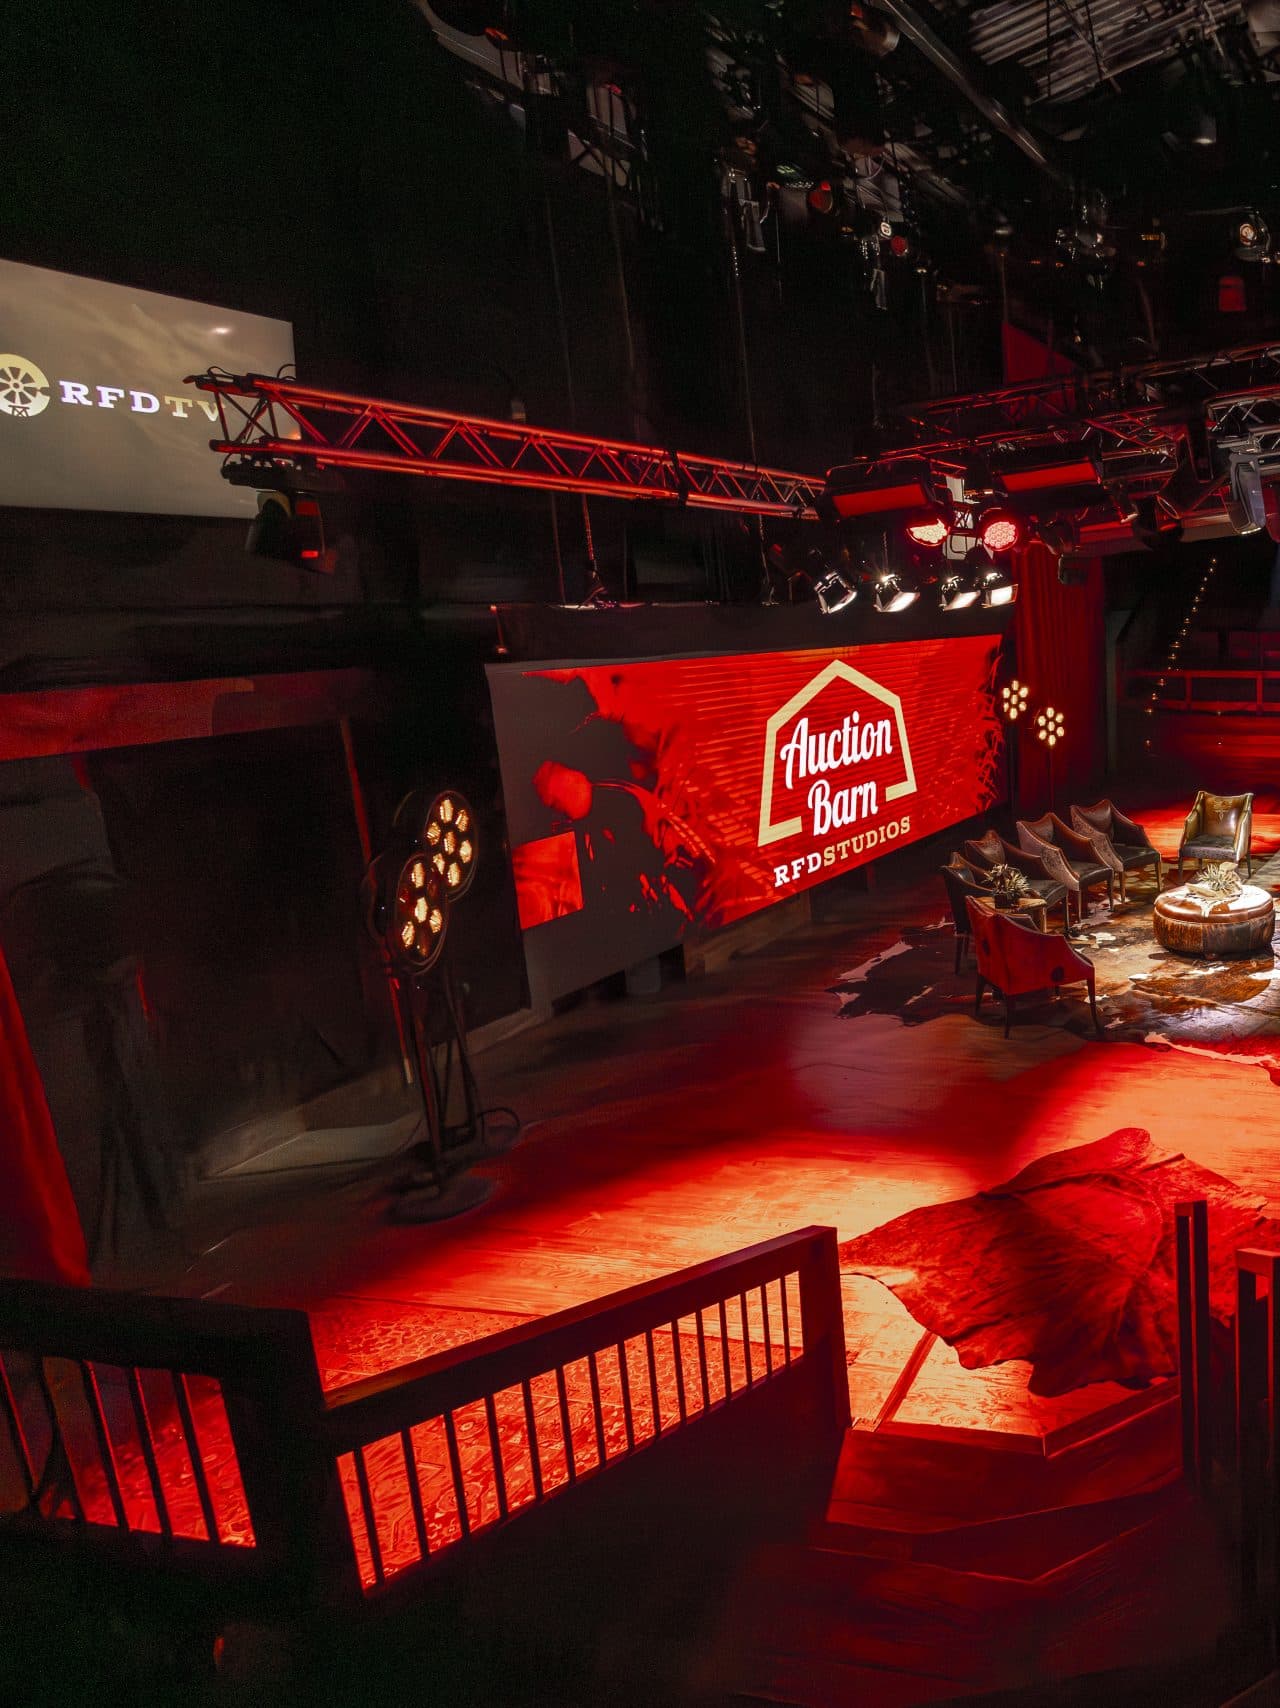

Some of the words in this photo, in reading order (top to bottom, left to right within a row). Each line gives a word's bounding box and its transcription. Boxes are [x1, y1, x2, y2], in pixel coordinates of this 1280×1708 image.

[780, 711, 892, 789] Auction
[807, 779, 878, 836] Barn
[773, 816, 910, 887] RFDSTUDIOS
